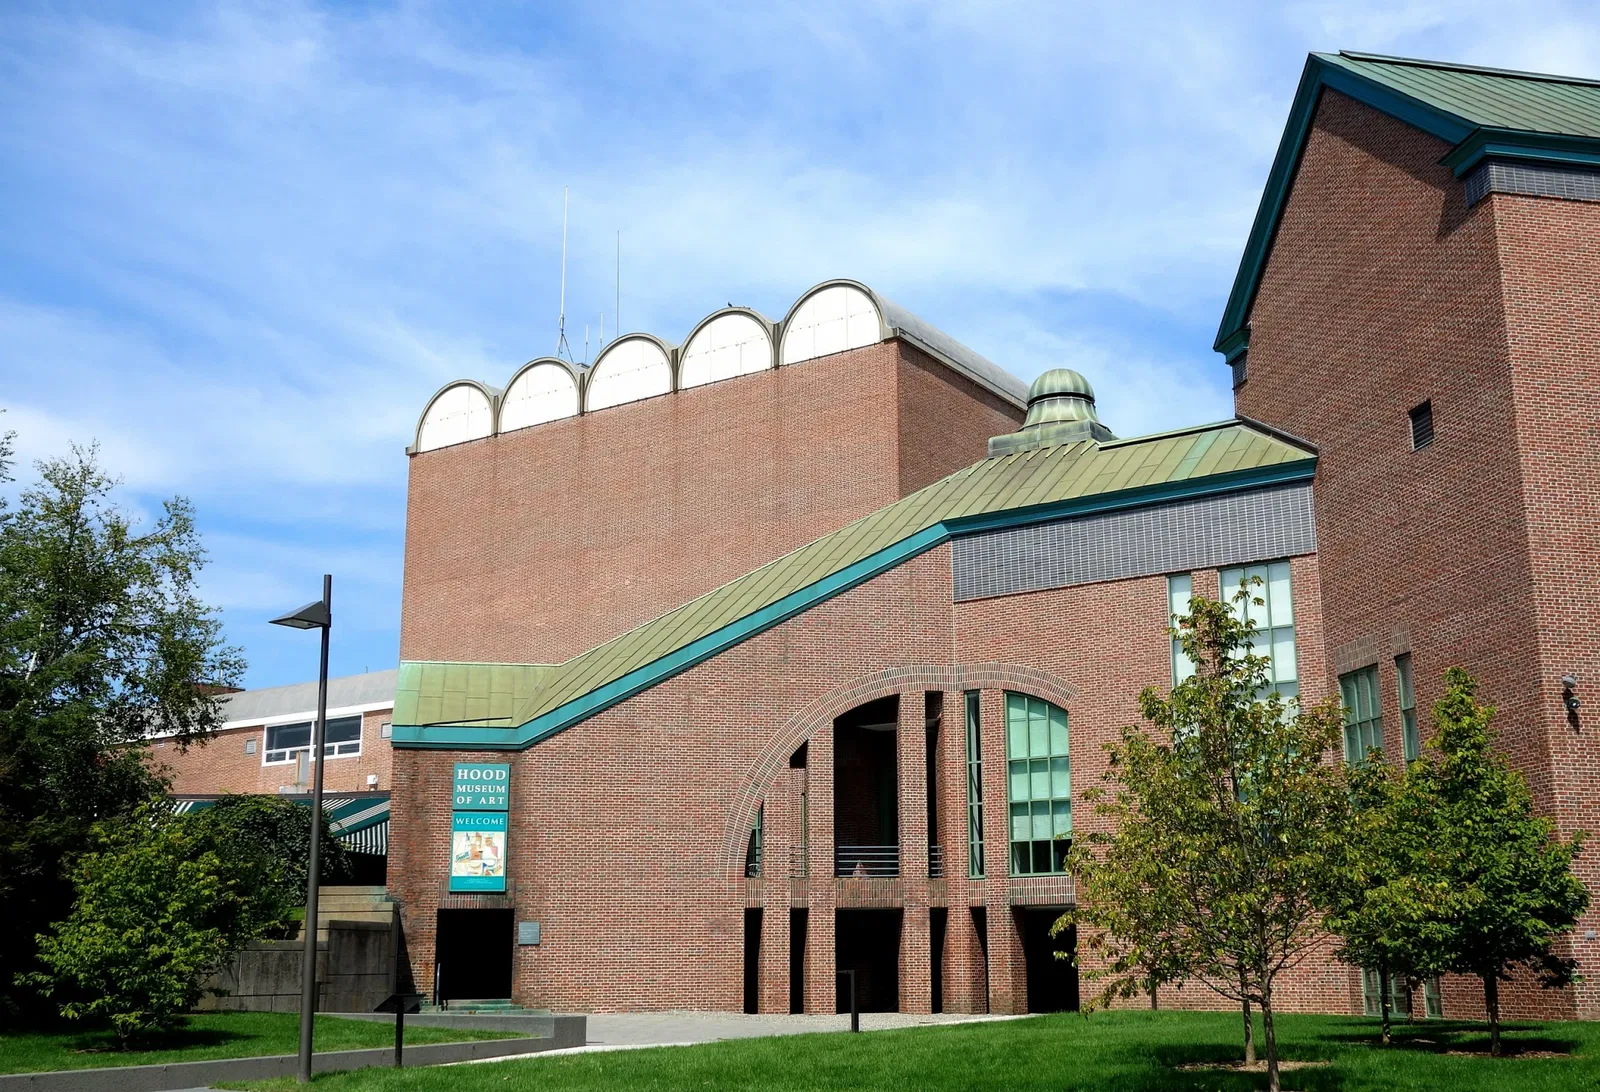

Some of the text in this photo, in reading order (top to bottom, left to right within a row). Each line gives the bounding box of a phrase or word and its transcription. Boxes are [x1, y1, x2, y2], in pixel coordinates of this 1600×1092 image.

[457, 769, 506, 780] HOOD
[456, 784, 505, 793] MUSEUM
[456, 796, 505, 805] OF ART
[455, 817, 504, 825] WELCOME
